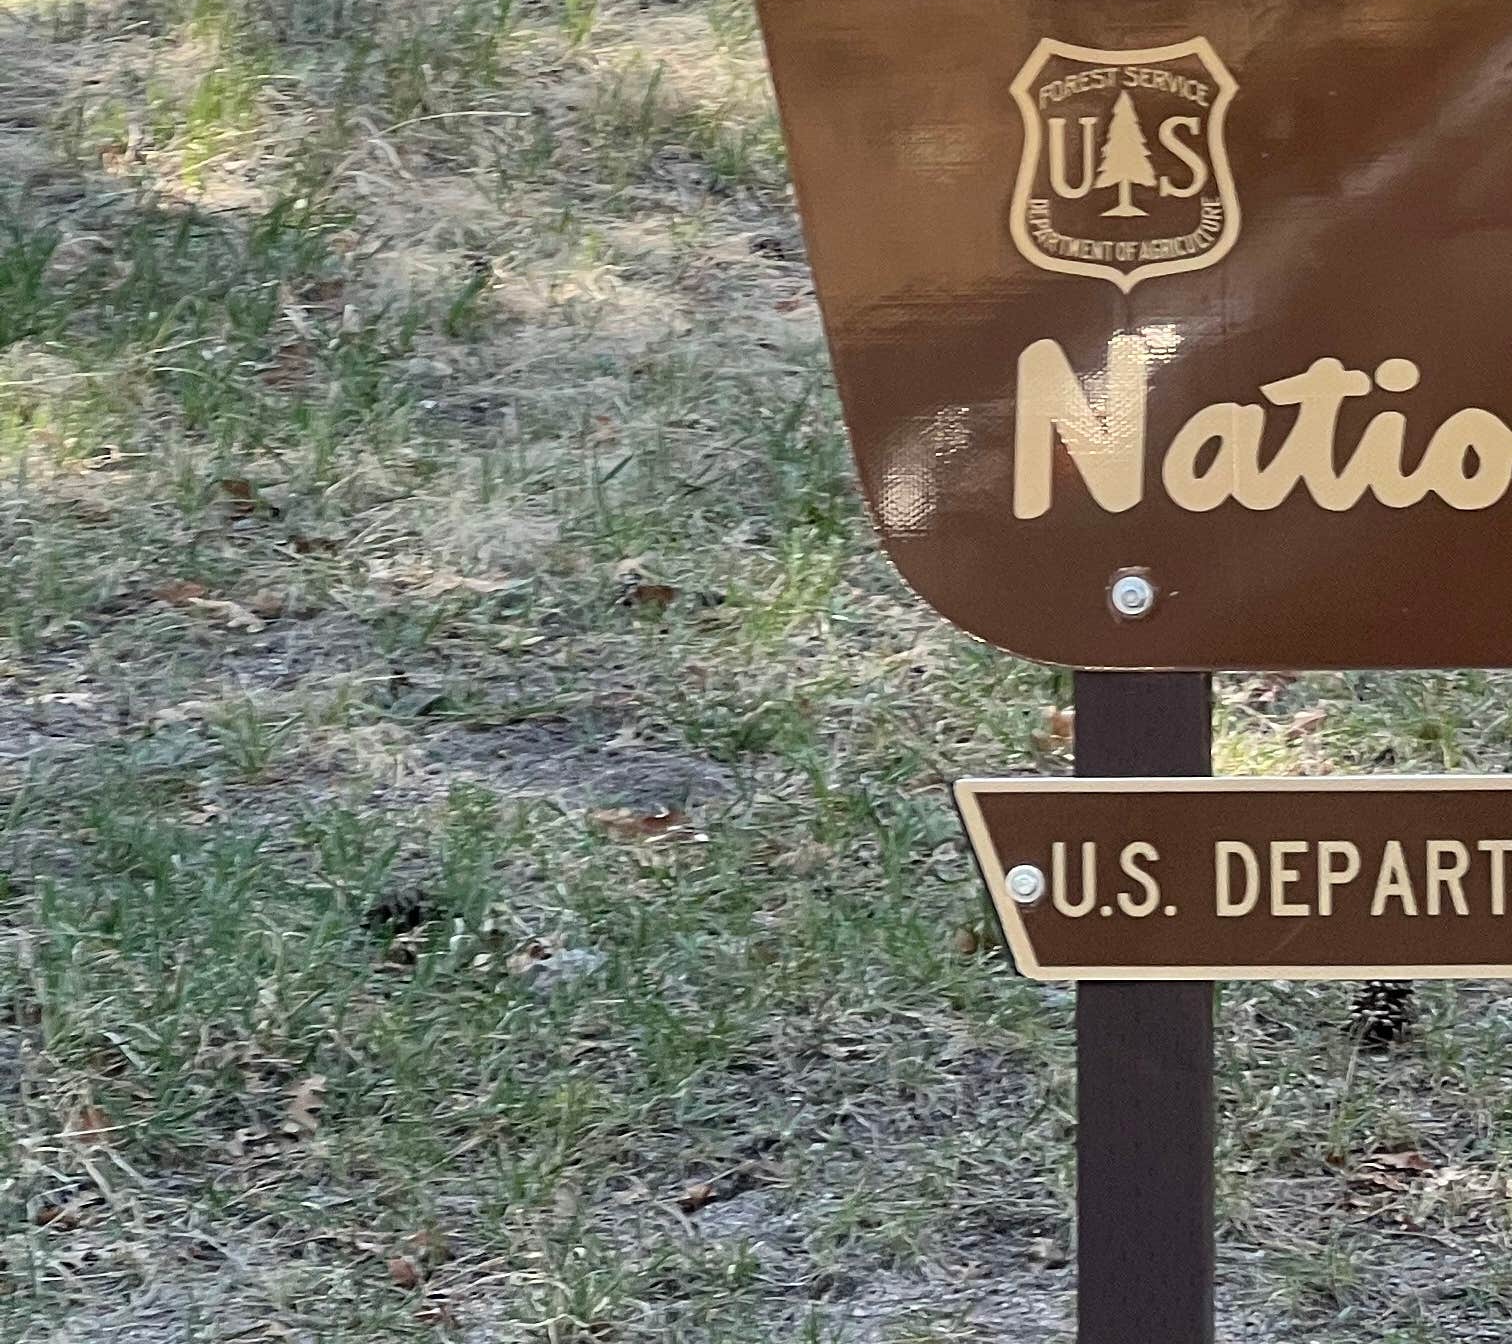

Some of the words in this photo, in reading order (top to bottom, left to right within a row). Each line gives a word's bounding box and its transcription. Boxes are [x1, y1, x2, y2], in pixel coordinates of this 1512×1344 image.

[1039, 67, 1119, 110] FOREST
[1123, 66, 1209, 107] SERVICE
[1115, 241, 1138, 261] OF
[1049, 839, 1179, 920] U.S.
